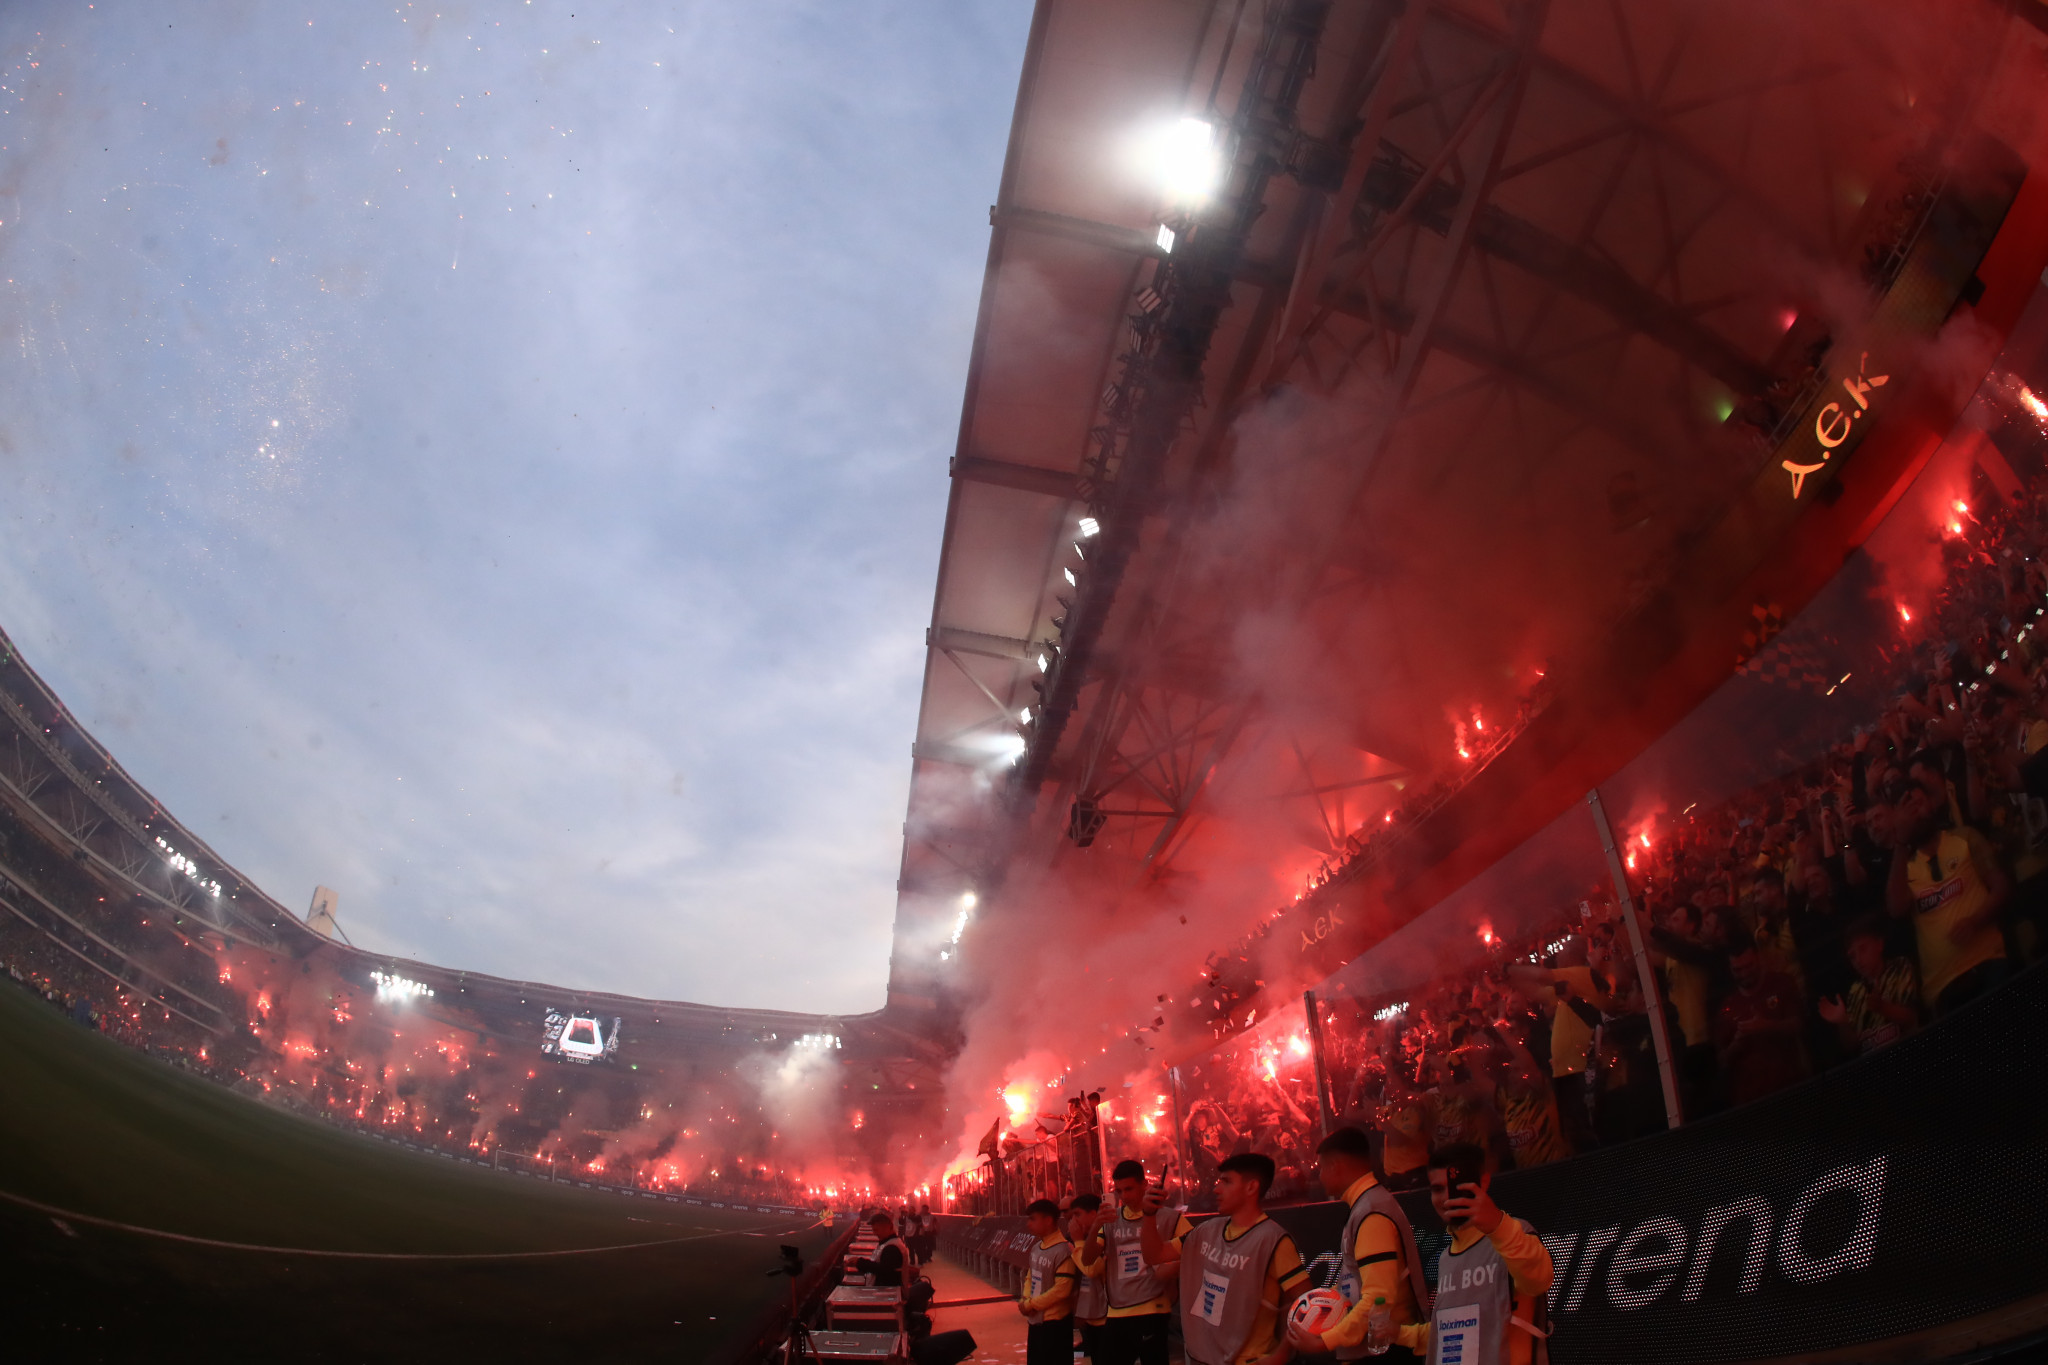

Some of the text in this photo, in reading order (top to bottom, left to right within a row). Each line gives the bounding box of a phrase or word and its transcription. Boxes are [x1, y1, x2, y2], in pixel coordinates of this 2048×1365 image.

[1113, 1227, 1133, 1239] ALL
[1221, 1252, 1250, 1270] BOY
[1438, 1263, 1498, 1294] LL BOY
